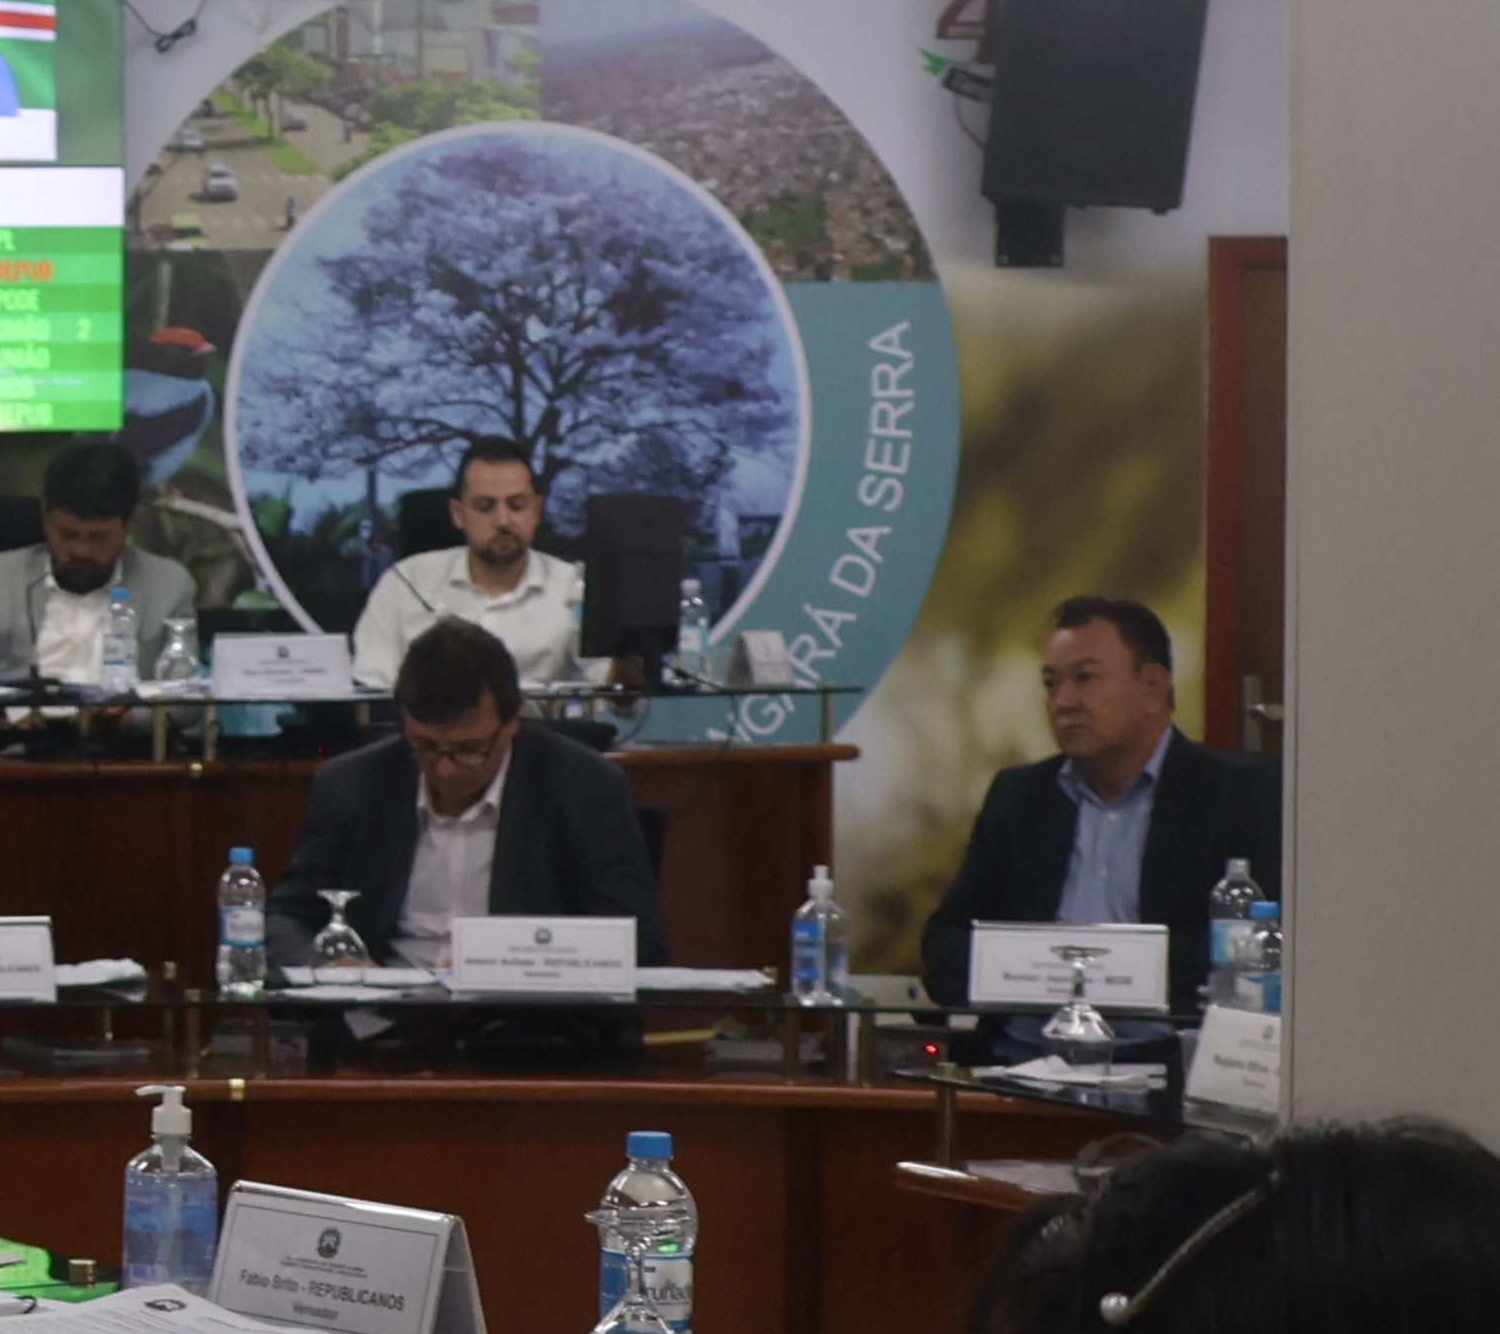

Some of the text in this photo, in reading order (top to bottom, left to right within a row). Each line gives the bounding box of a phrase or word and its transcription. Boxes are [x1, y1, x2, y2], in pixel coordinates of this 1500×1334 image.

[77, 318, 92, 341] 2
[857, 321, 914, 512] SERRA
[829, 525, 892, 598] DA
[240, 1268, 270, 1288] Fabio
[271, 1274, 300, 1292] Brito
[308, 1280, 405, 1311] REPUBLICANOS
